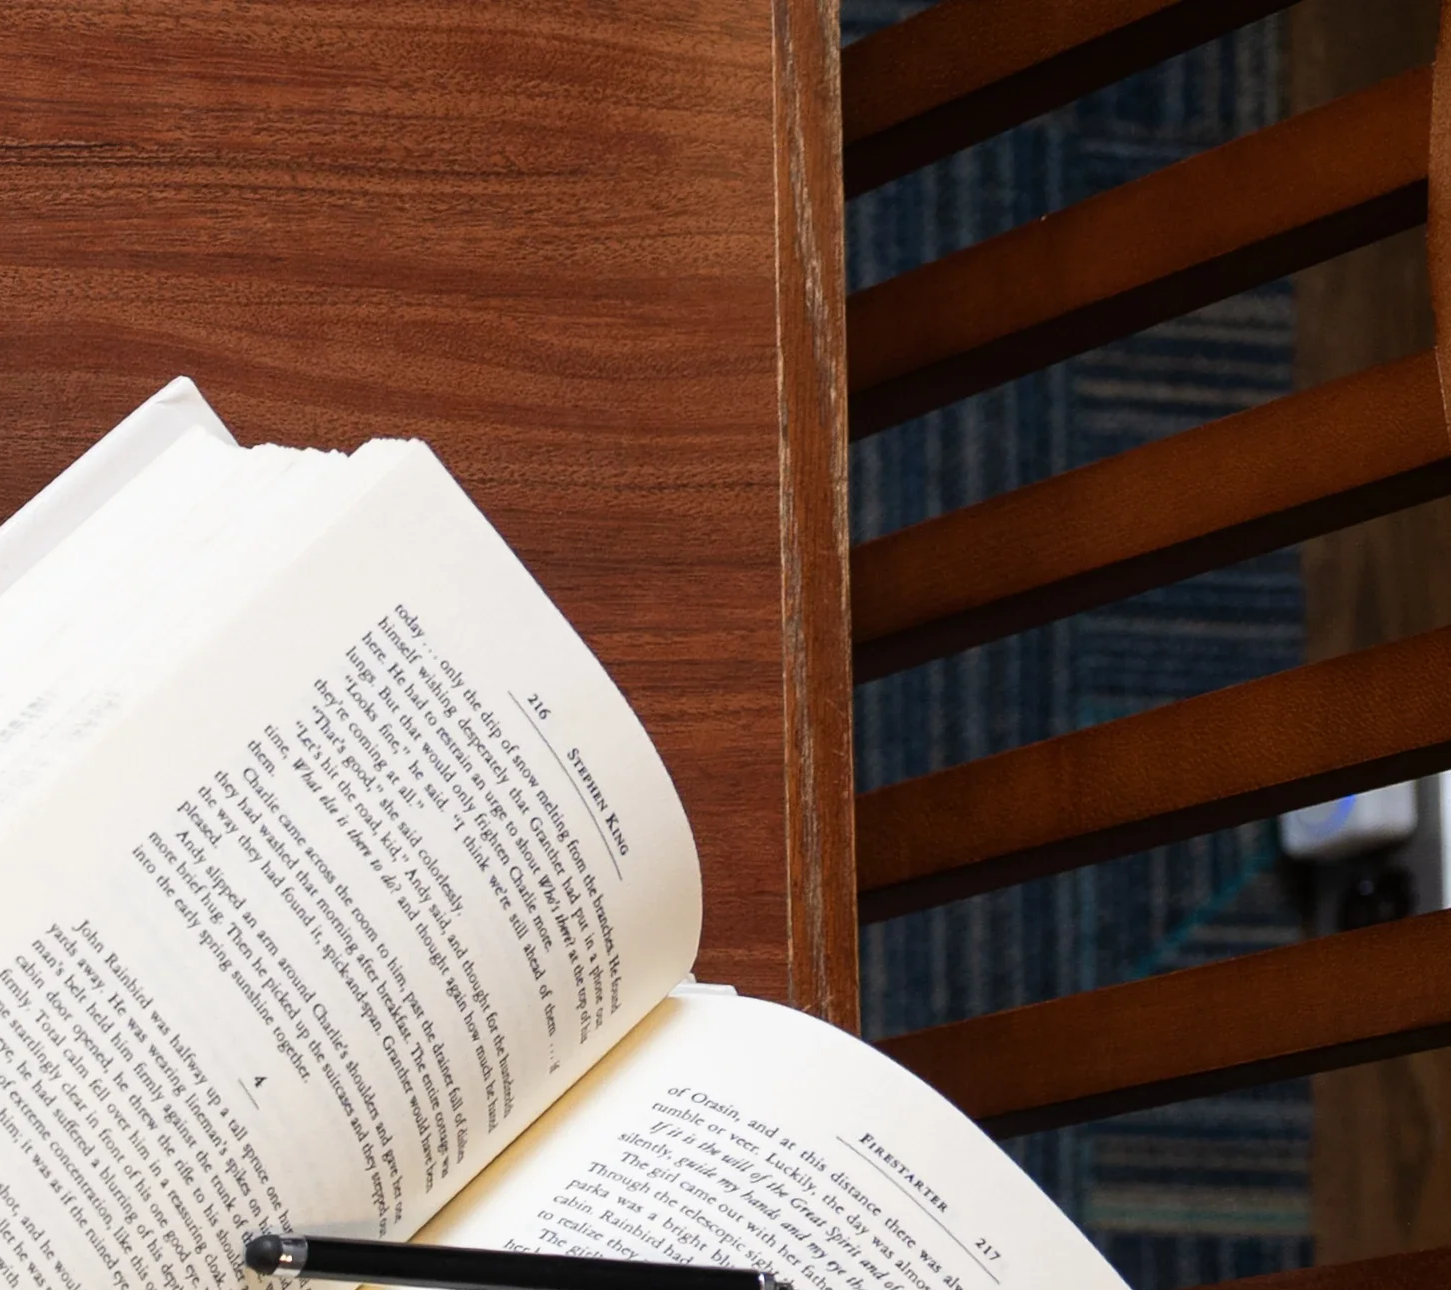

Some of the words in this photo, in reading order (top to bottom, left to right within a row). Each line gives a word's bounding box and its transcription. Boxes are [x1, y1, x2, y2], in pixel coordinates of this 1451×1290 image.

[526, 692, 551, 720] 216
[344, 644, 376, 686] lungs.
[377, 684, 400, 713] But
[398, 714, 422, 741] that
[421, 741, 457, 783] would
[451, 783, 476, 813] only
[473, 812, 510, 866] frighten
[508, 865, 536, 914] Charlie
[532, 914, 552, 952] more.
[131, 843, 156, 874] into
[155, 874, 175, 897] the
[173, 898, 201, 928] early
[198, 928, 232, 972] spring
[230, 969, 274, 1025] sunshine
[272, 1025, 310, 1083] together.
[70, 918, 104, 953] John
[103, 951, 154, 1009] Rainbird
[150, 1009, 170, 1036] was
[168, 1033, 208, 1085] halfway
[206, 1086, 221, 1106] up
[219, 1107, 229, 1118] a
[227, 1118, 248, 1141] tall
[240, 1142, 269, 1184] spruce
[266, 1185, 282, 1211] one
[253, 1075, 267, 1088] 4
[651, 1102, 705, 1125] tumble
[706, 1123, 726, 1134] or
[729, 1132, 759, 1155] veer.
[764, 1152, 816, 1195] Luckily,
[821, 1194, 845, 1214] the
[845, 1213, 869, 1235] day
[871, 1235, 894, 1259] was
[667, 1087, 691, 1097] of
[690, 1092, 740, 1122] Orasin,
[746, 1119, 779, 1138] and
[778, 1137, 796, 1150] at
[799, 1150, 827, 1172] this
[829, 1171, 881, 1216] distance
[883, 1217, 916, 1248] there
[919, 1248, 942, 1273] was
[974, 1237, 1001, 1260] 217
